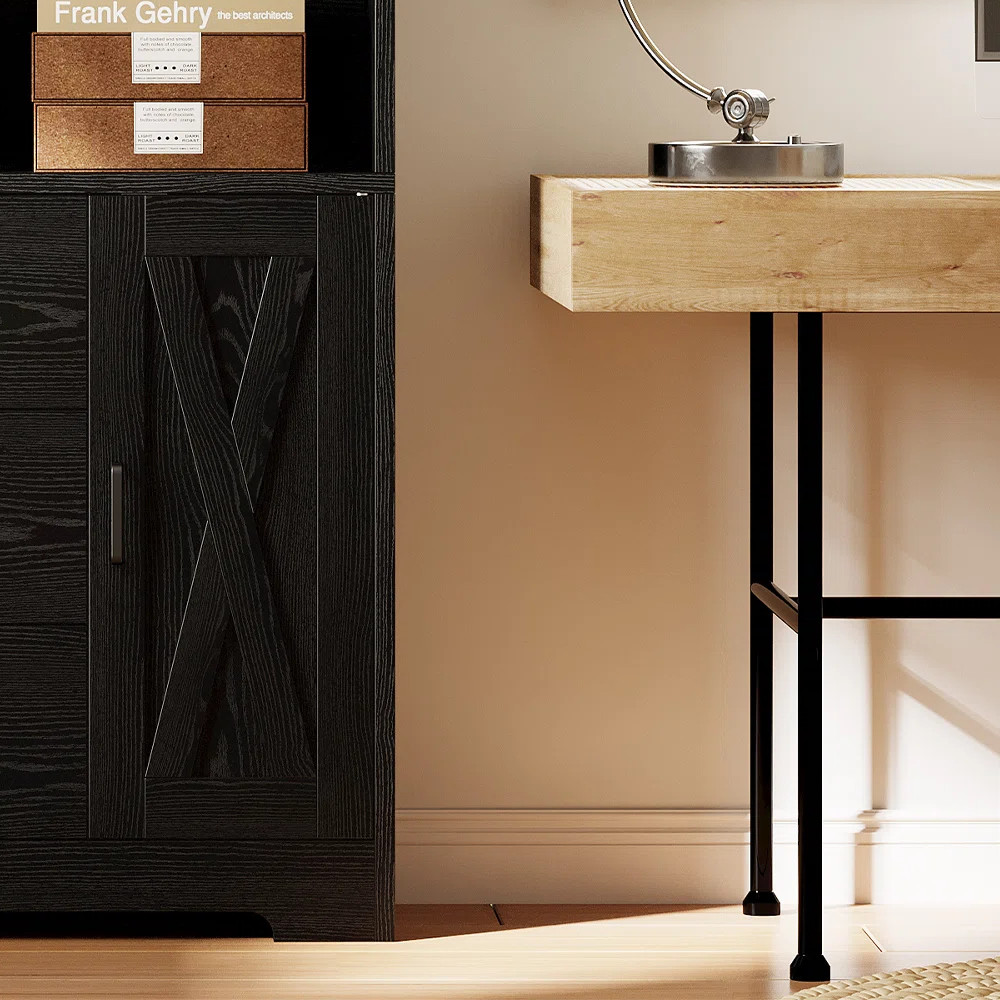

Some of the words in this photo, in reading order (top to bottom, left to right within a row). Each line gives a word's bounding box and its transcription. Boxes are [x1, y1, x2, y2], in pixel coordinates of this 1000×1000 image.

[55, 1, 127, 24] Frank
[135, 1, 213, 30] Gehry
[217, 10, 231, 20] the
[233, 10, 252, 20] best
[252, 10, 294, 20] architects
